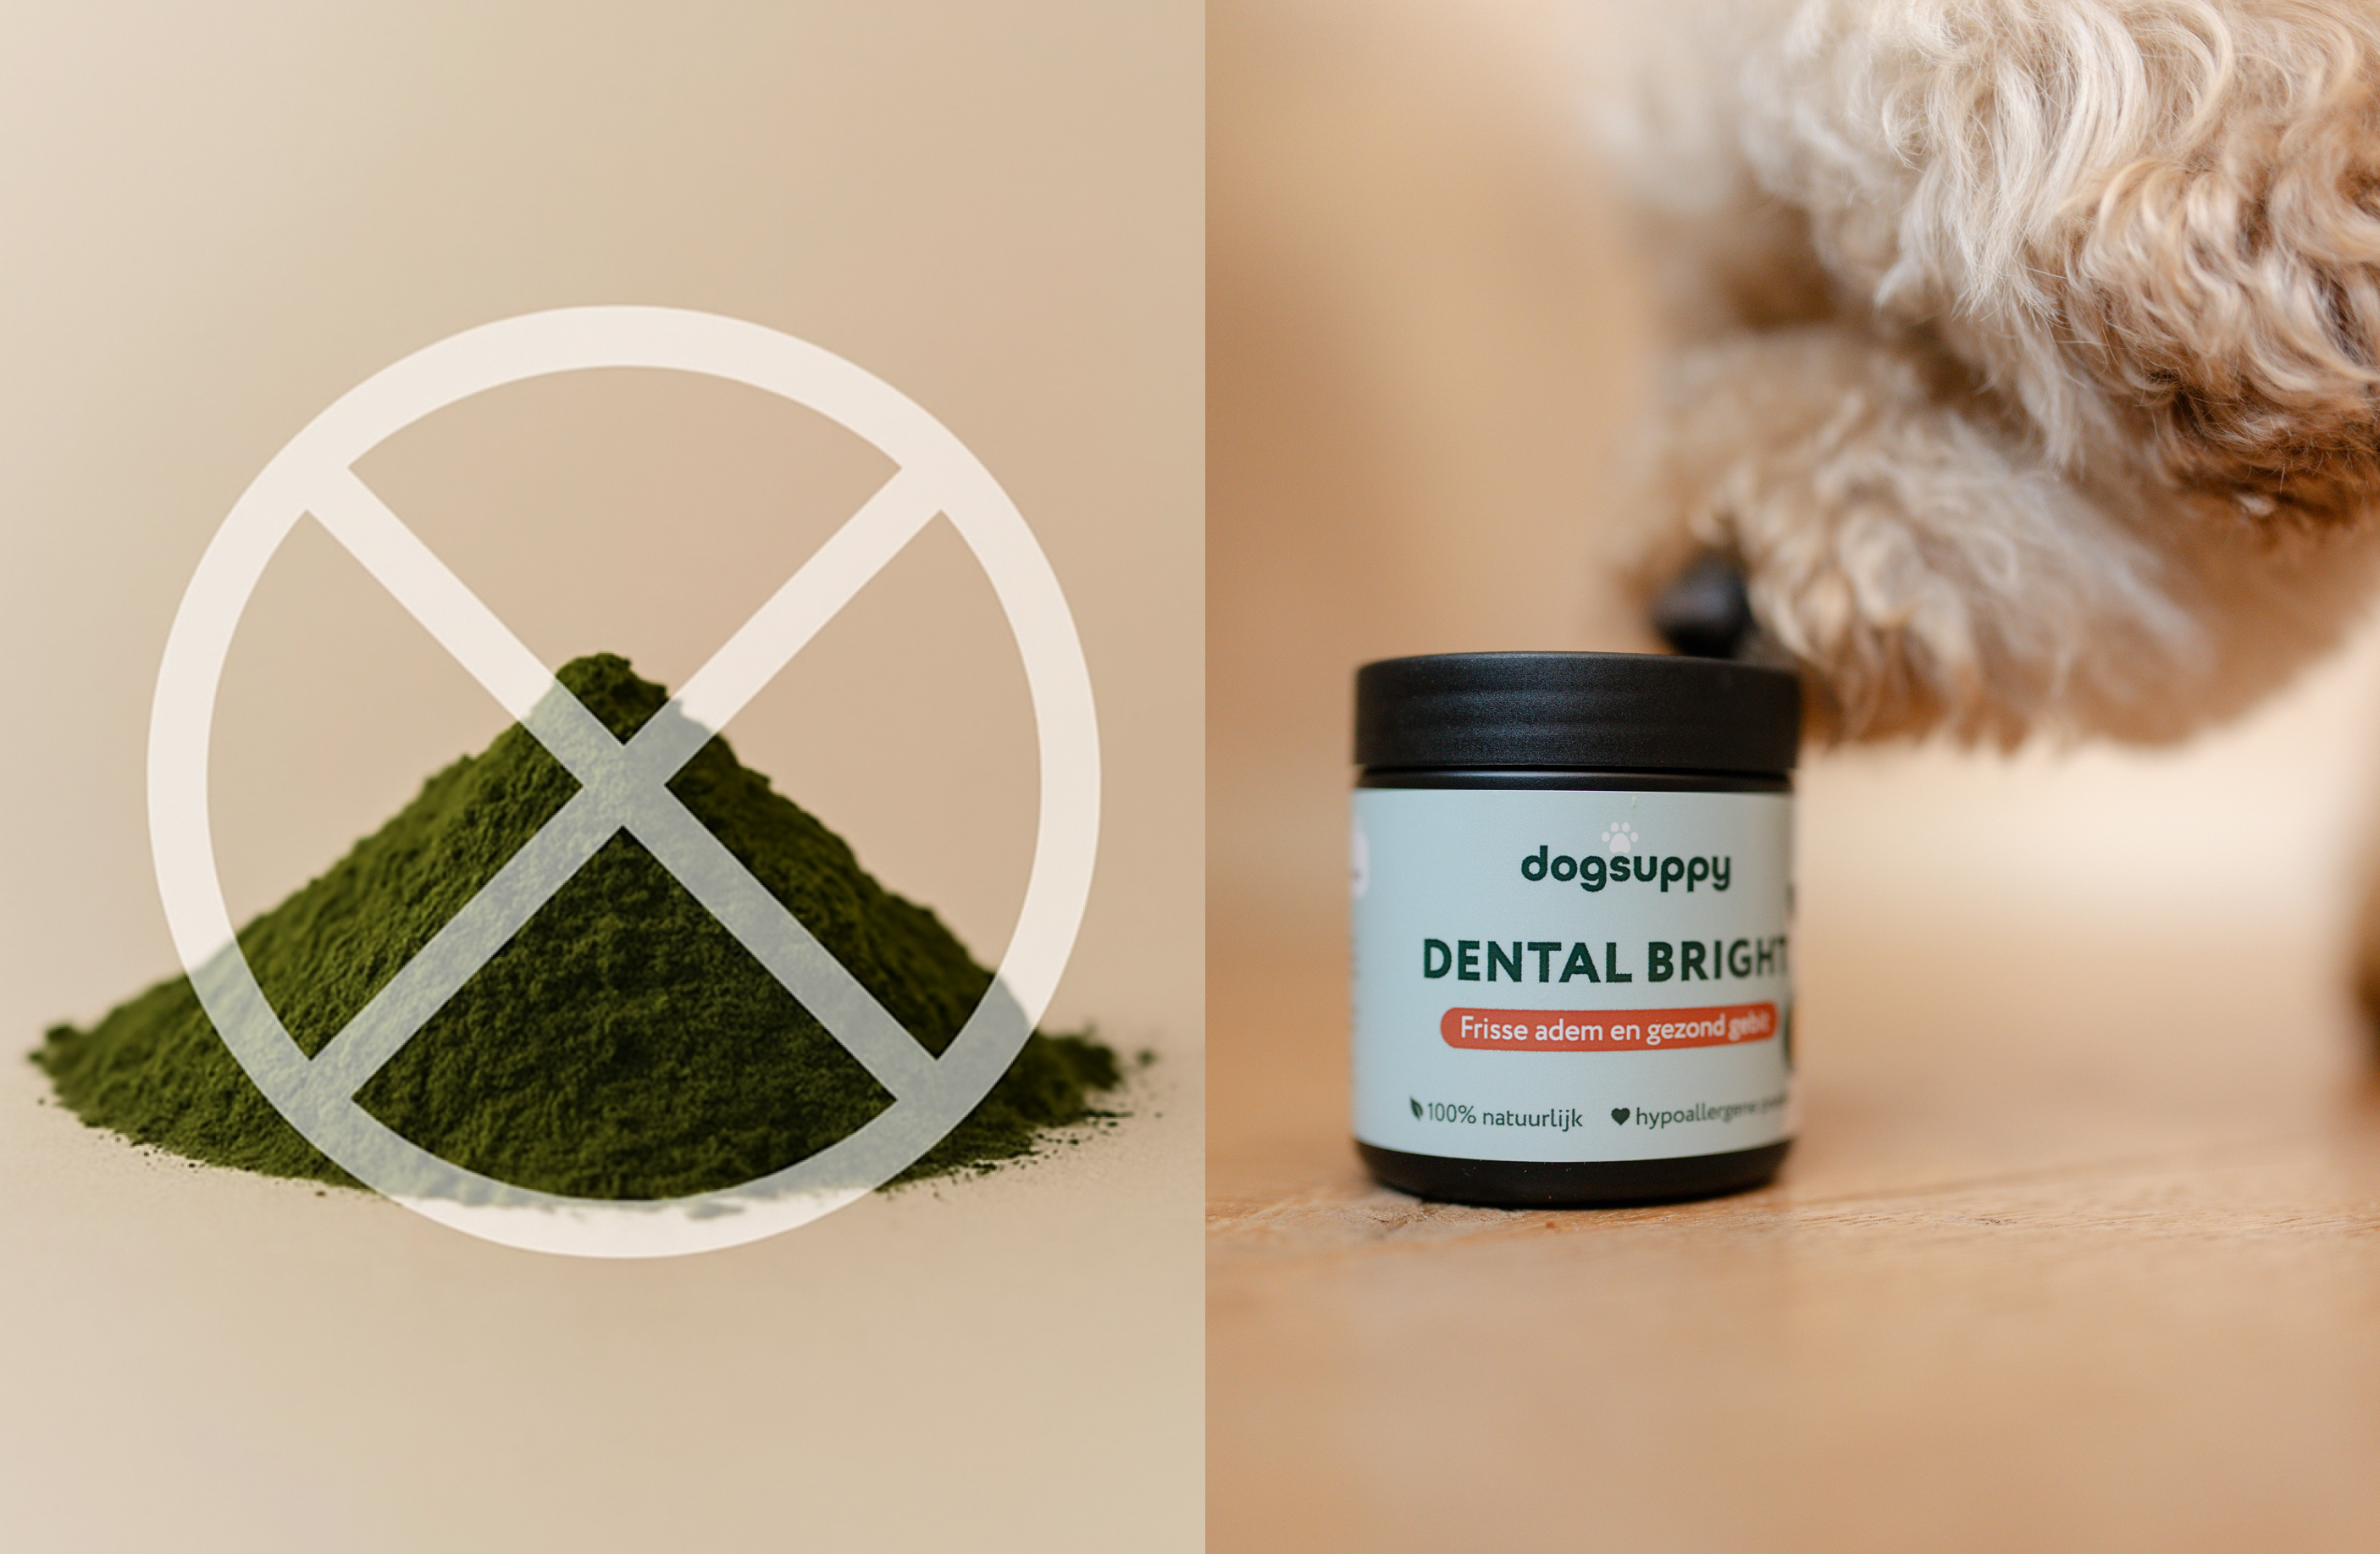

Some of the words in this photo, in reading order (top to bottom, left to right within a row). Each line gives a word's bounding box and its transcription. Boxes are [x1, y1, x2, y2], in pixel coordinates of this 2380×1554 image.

[1521, 845, 1730, 892] dogsuppy
[1424, 938, 1632, 982] DENTAL
[1461, 1015, 1528, 1041] Frisse
[1535, 1018, 1603, 1041] adem
[1610, 1023, 1641, 1041] en
[1647, 1013, 1726, 1045] gezond
[1427, 1102, 1476, 1124] 100%
[1482, 1109, 1583, 1131] natuurlijk
